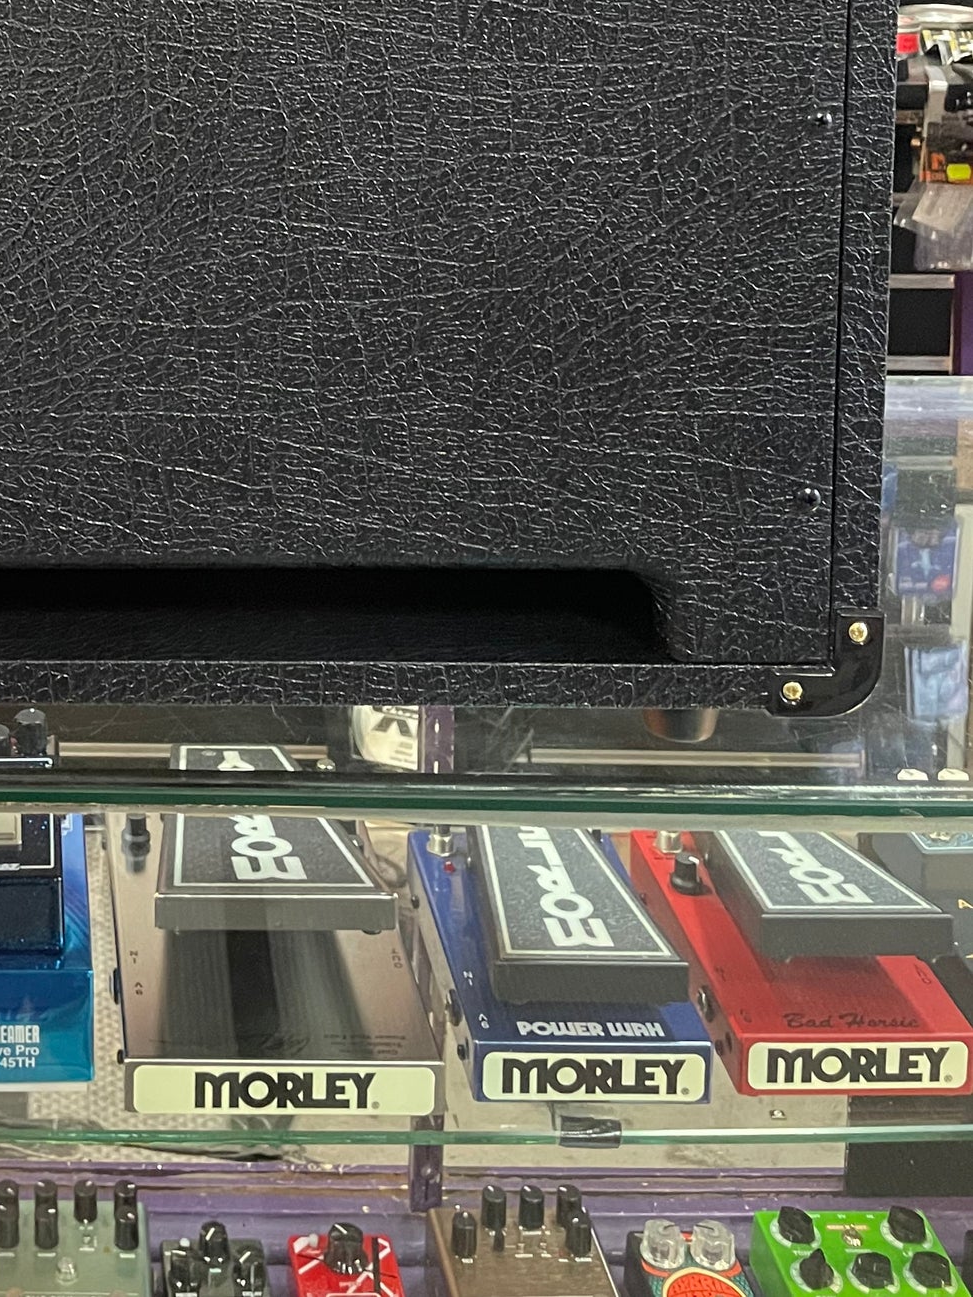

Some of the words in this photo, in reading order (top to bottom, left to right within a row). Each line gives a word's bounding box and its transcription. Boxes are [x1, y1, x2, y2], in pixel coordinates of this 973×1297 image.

[516, 1020, 606, 1037] POWER
[606, 1022, 666, 1037] WAH
[783, 1012, 834, 1029] Bad
[838, 1012, 920, 1029] Horsie
[15, 1044, 40, 1057] Pro
[0, 1057, 36, 1069] 45TH
[767, 1047, 950, 1084] MORLEY
[502, 1058, 686, 1095] MORLEY
[194, 1072, 377, 1109] MORLEY
